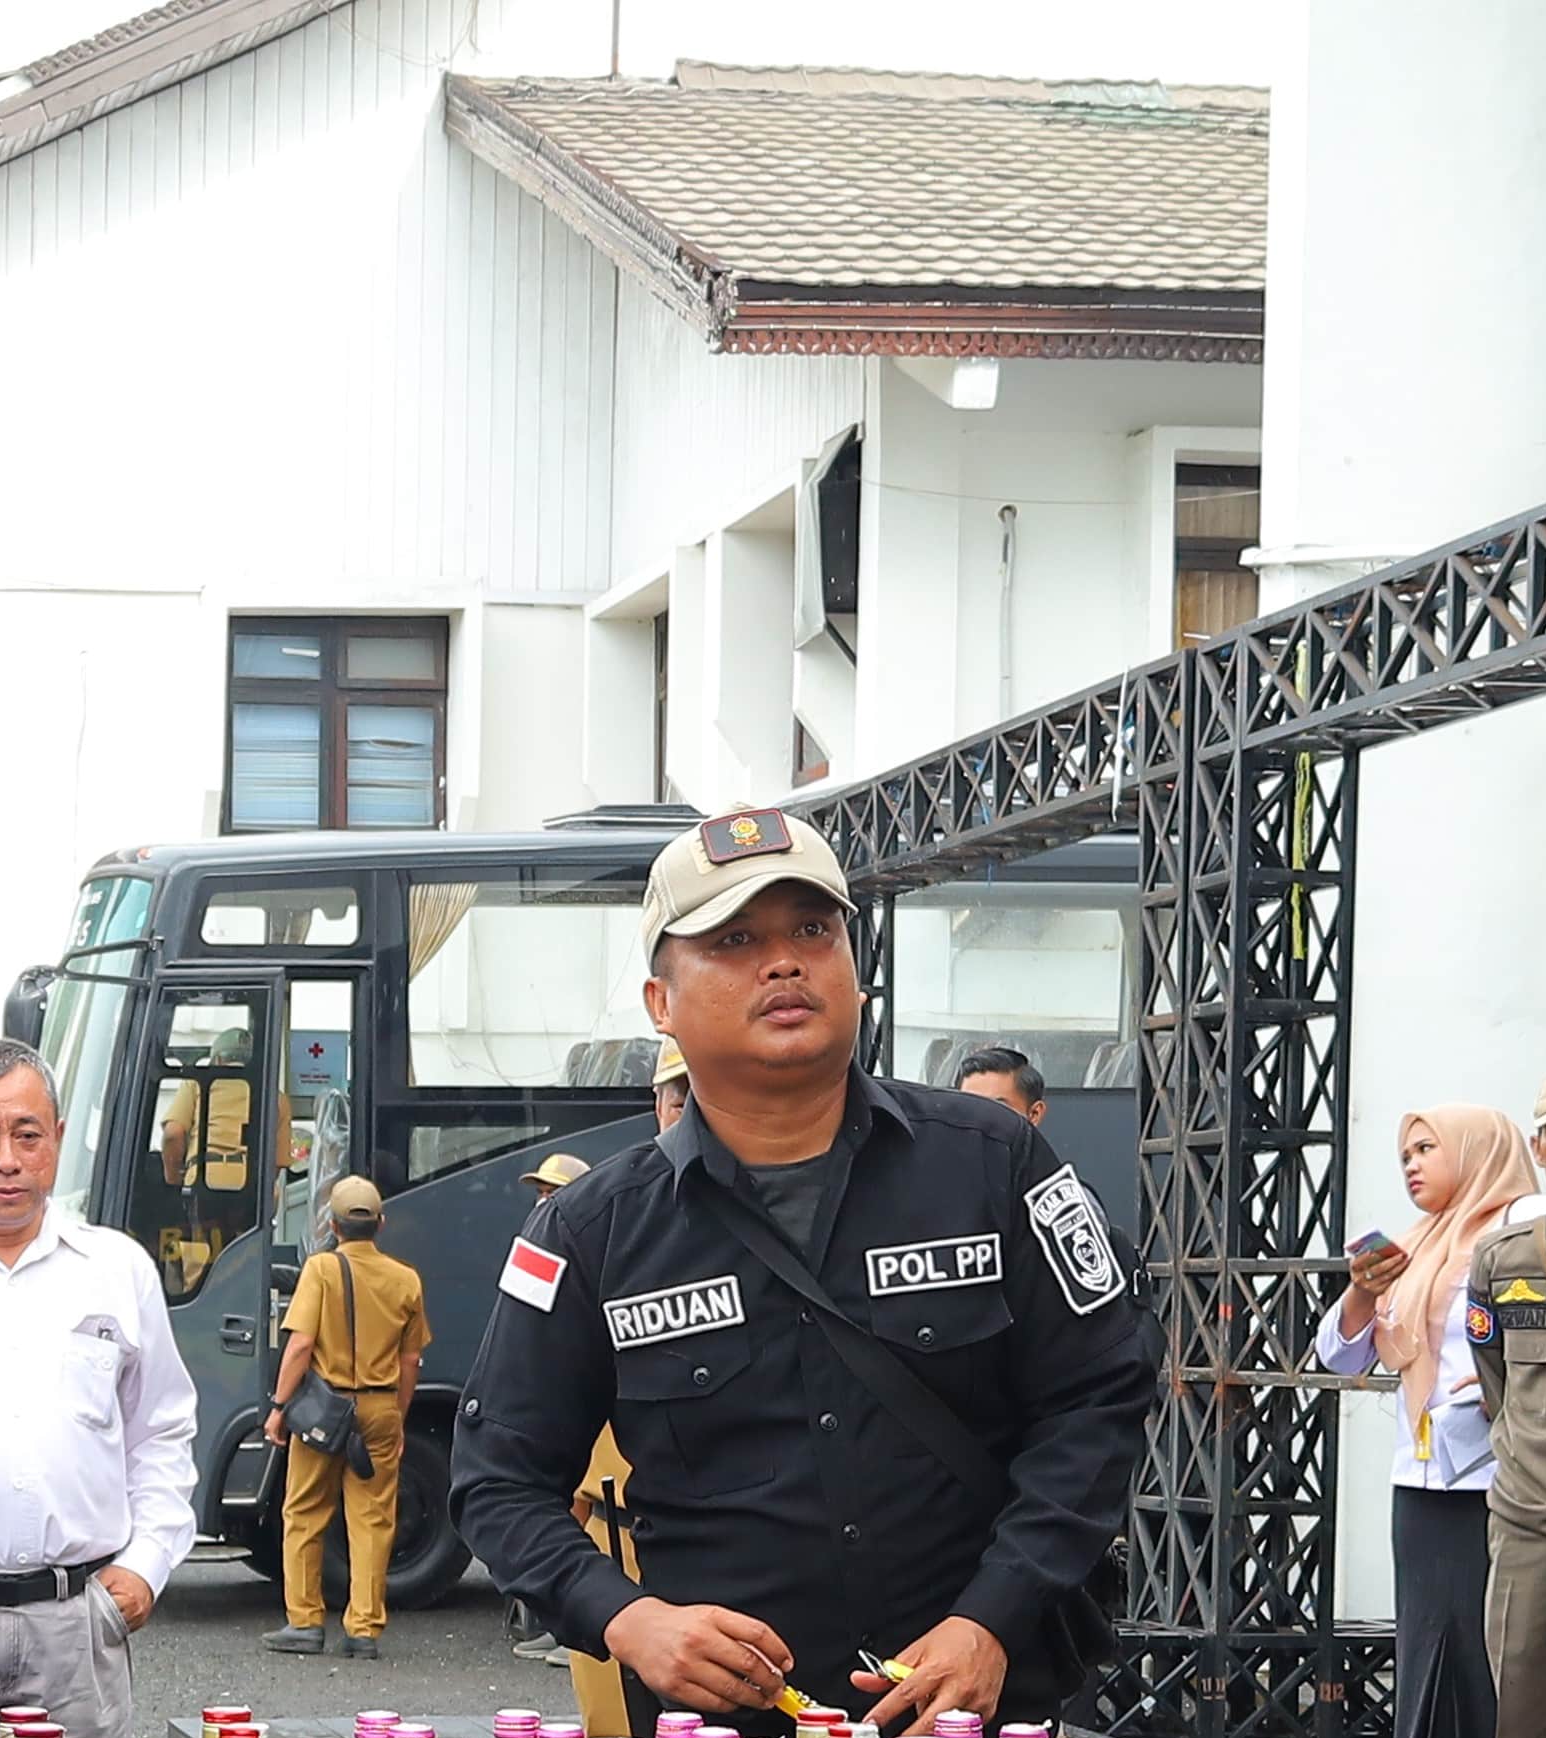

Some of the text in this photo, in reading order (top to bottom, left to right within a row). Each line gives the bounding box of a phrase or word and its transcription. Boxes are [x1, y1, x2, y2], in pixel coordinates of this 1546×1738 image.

[878, 1244, 992, 1287] POL PP
[611, 1285, 734, 1340] RIDUAN
